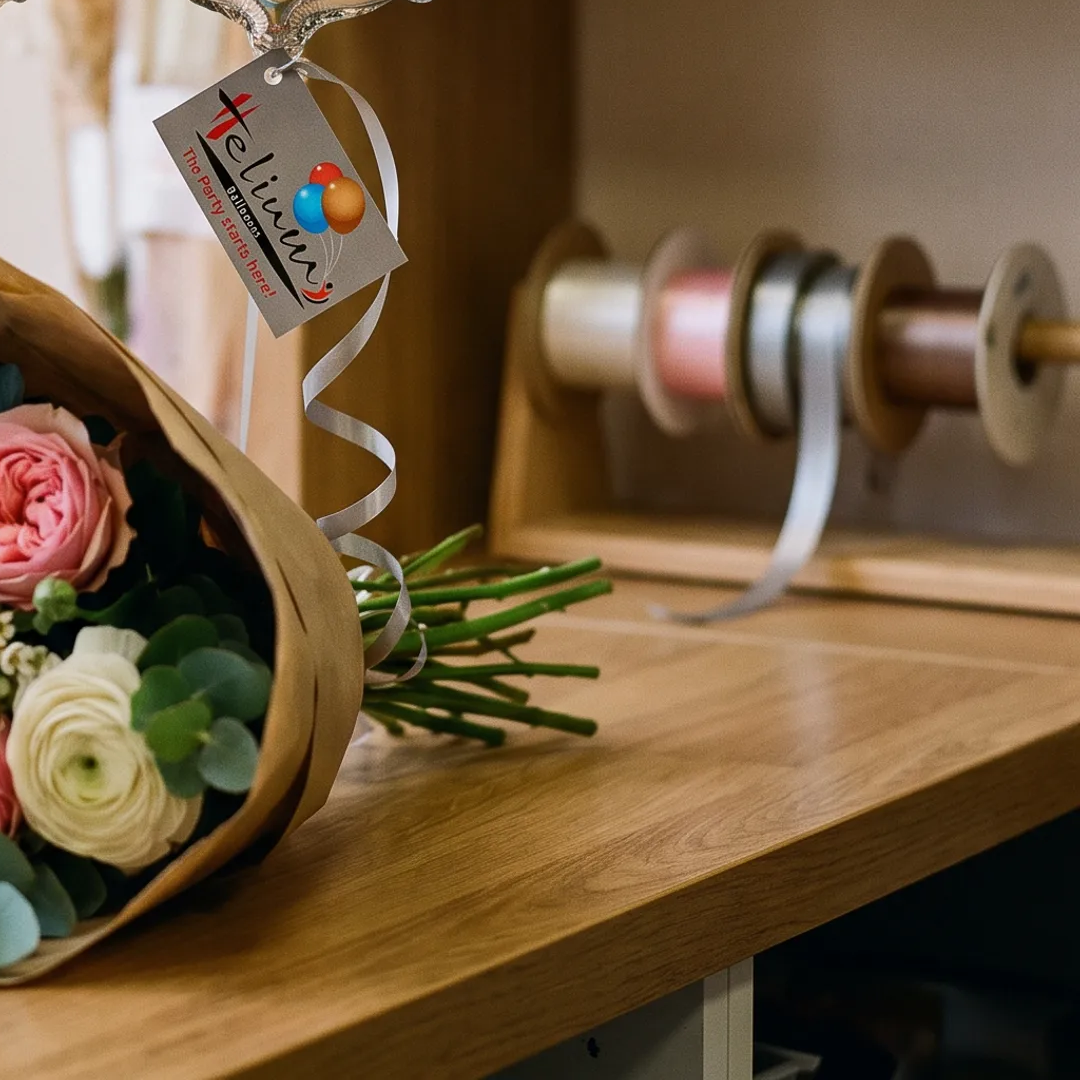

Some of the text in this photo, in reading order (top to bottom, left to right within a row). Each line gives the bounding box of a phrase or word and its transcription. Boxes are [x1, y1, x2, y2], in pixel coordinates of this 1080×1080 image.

[183, 146, 277, 299] The Party starts here!
[206, 87, 319, 286] Helium
[226, 185, 261, 239] Balloons
